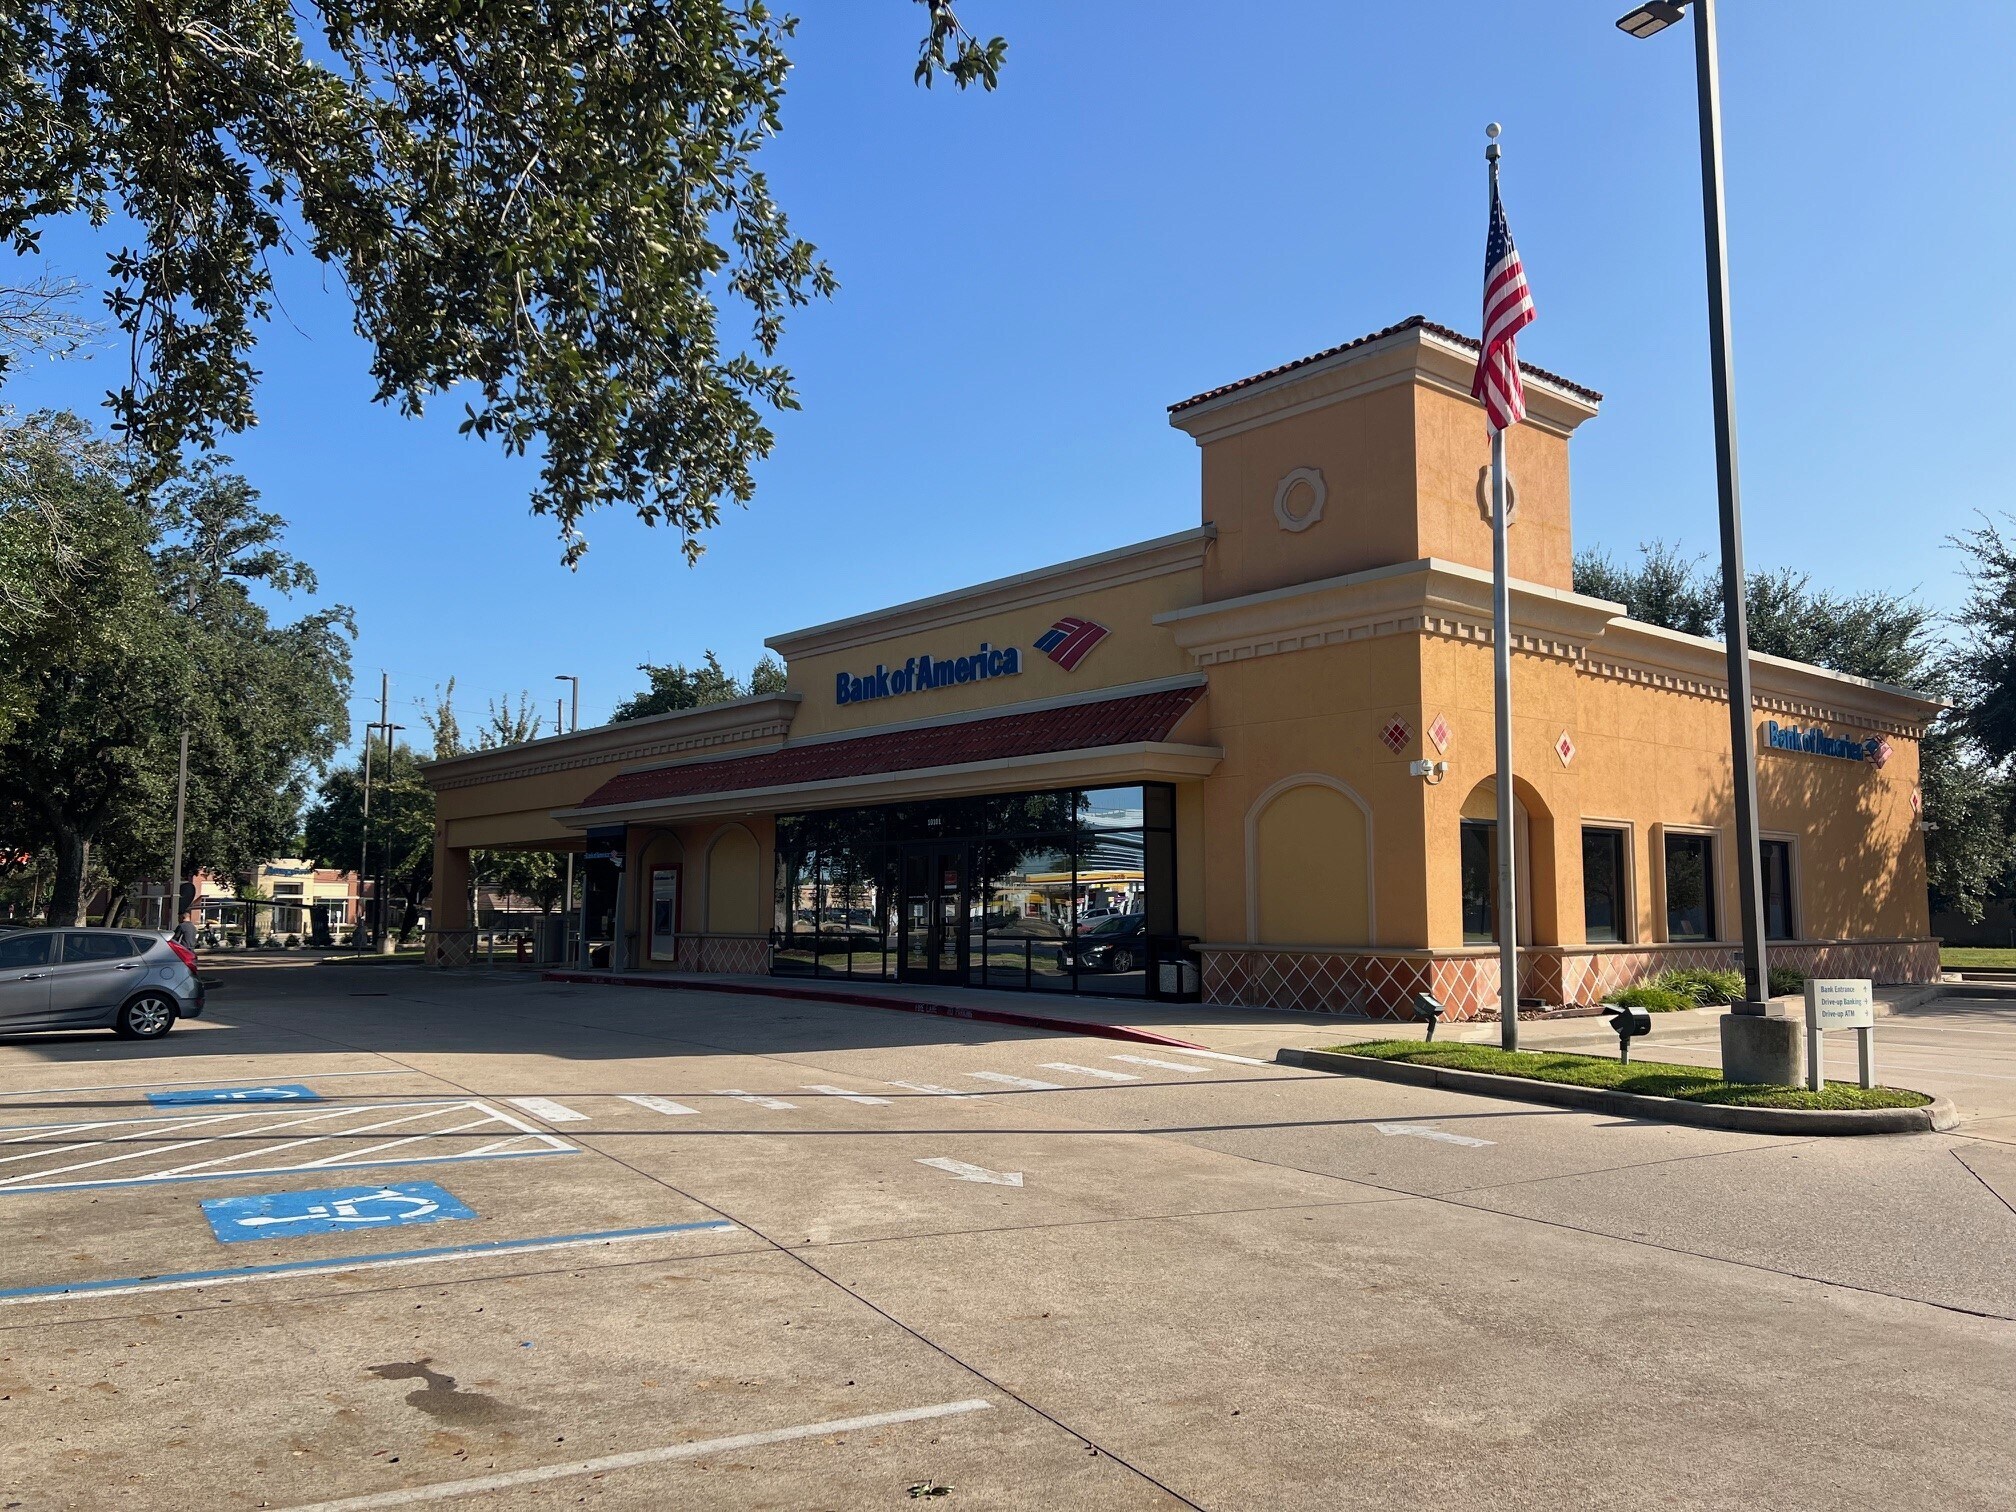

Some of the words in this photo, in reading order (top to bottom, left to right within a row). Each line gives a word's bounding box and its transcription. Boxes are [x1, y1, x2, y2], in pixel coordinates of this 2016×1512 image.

[836, 664, 890, 705] Bank
[891, 657, 916, 695] of
[916, 642, 1020, 691] America
[1769, 720, 1802, 752] Bank
[1802, 727, 1816, 753] of
[1816, 727, 1864, 761] America
[1821, 998, 1843, 1006] Drive-up
[1843, 998, 1862, 1006] Banking
[1822, 1010, 1844, 1018] Drive-up
